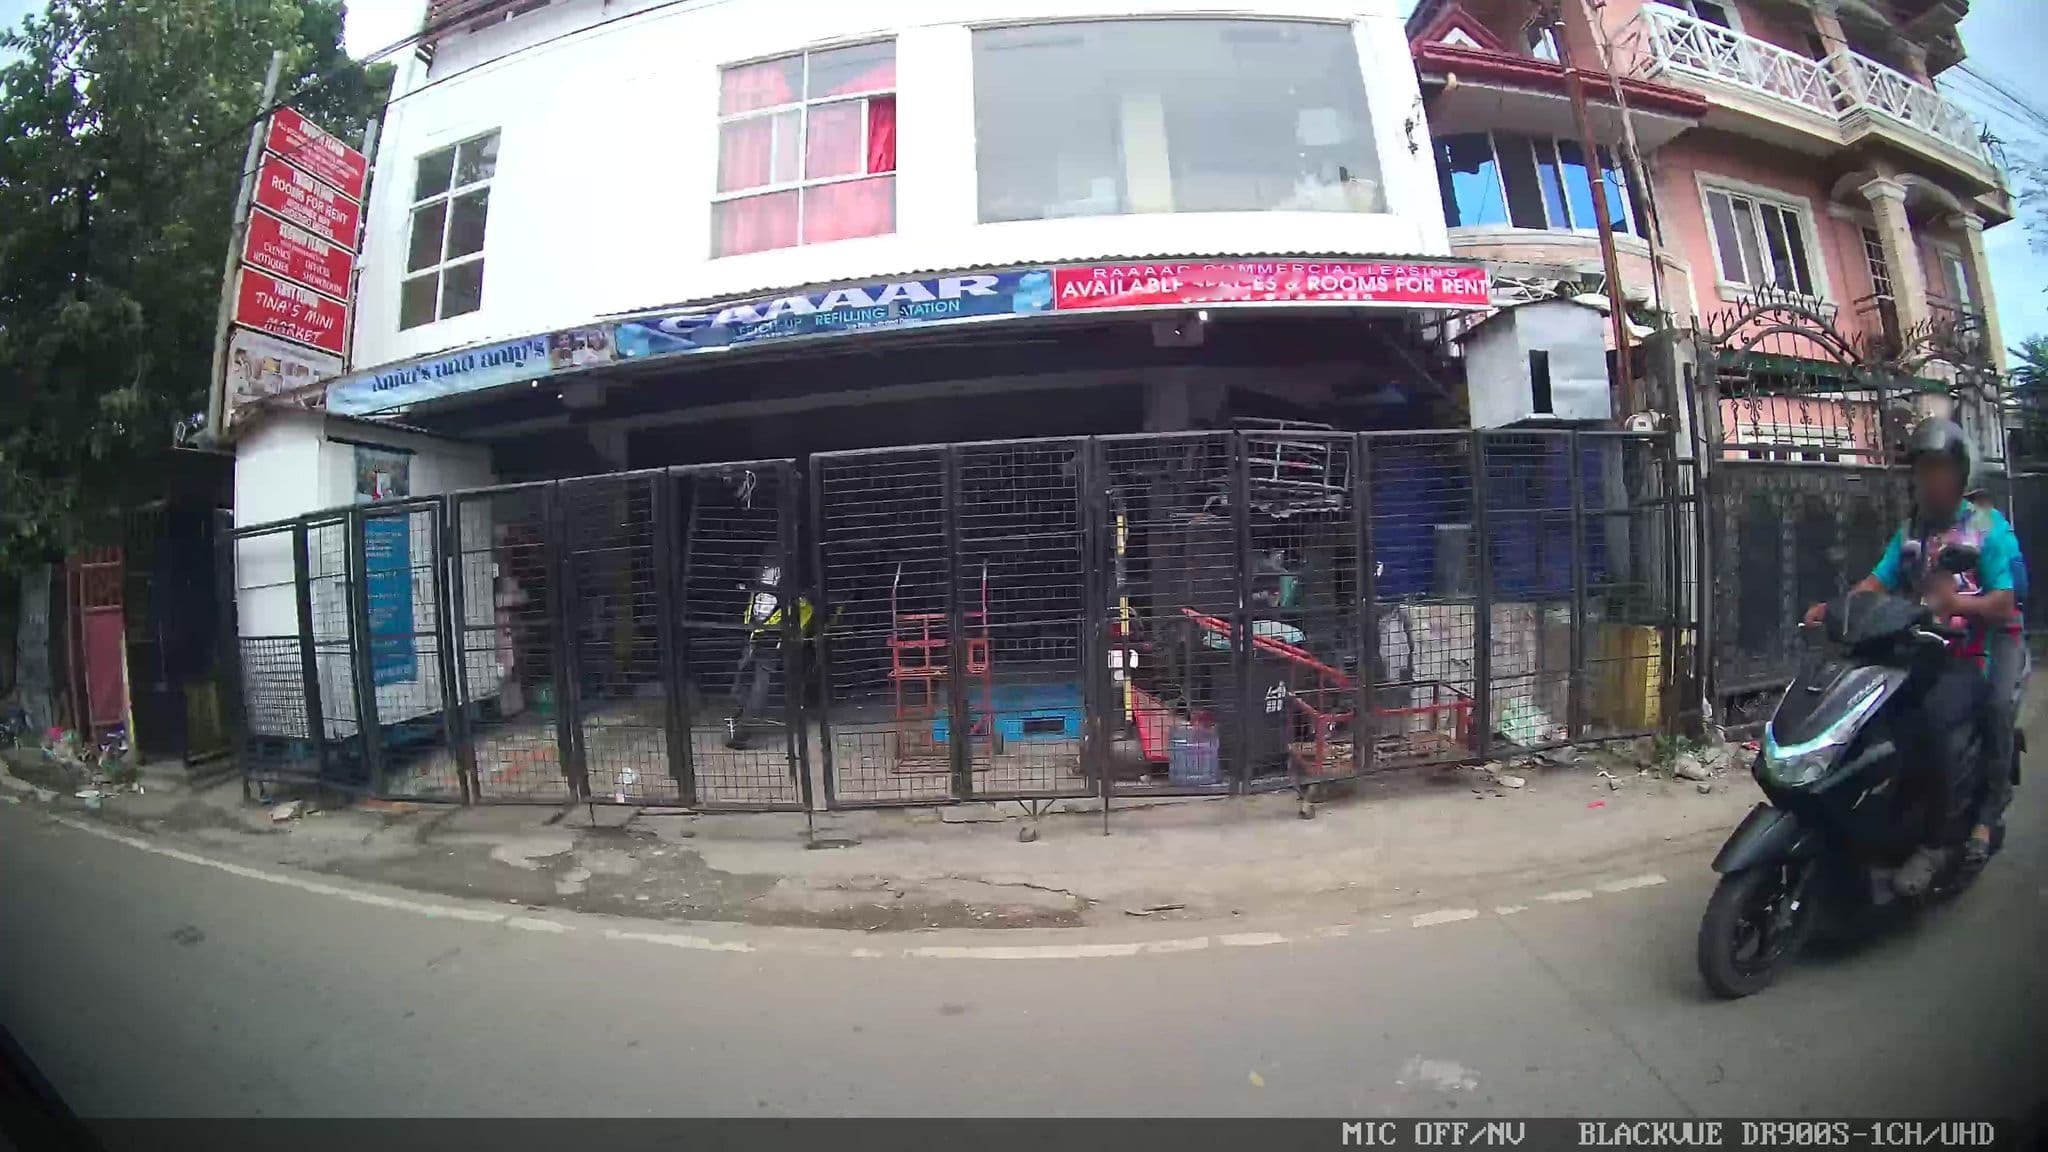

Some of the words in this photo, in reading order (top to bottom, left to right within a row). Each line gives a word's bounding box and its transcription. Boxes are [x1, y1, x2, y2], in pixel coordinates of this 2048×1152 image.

[306, 194, 325, 213] FOR
[325, 204, 348, 224] RENT
[1368, 264, 1458, 277] LEASING
[1307, 276, 1390, 292] ROOMS
[1395, 278, 1435, 293] FOR
[1442, 279, 1488, 296] RENT
[255, 291, 301, 317] TINA'S
[304, 310, 334, 330] MINI
[815, 307, 886, 326] REFILLING
[264, 317, 325, 343] MARKET
